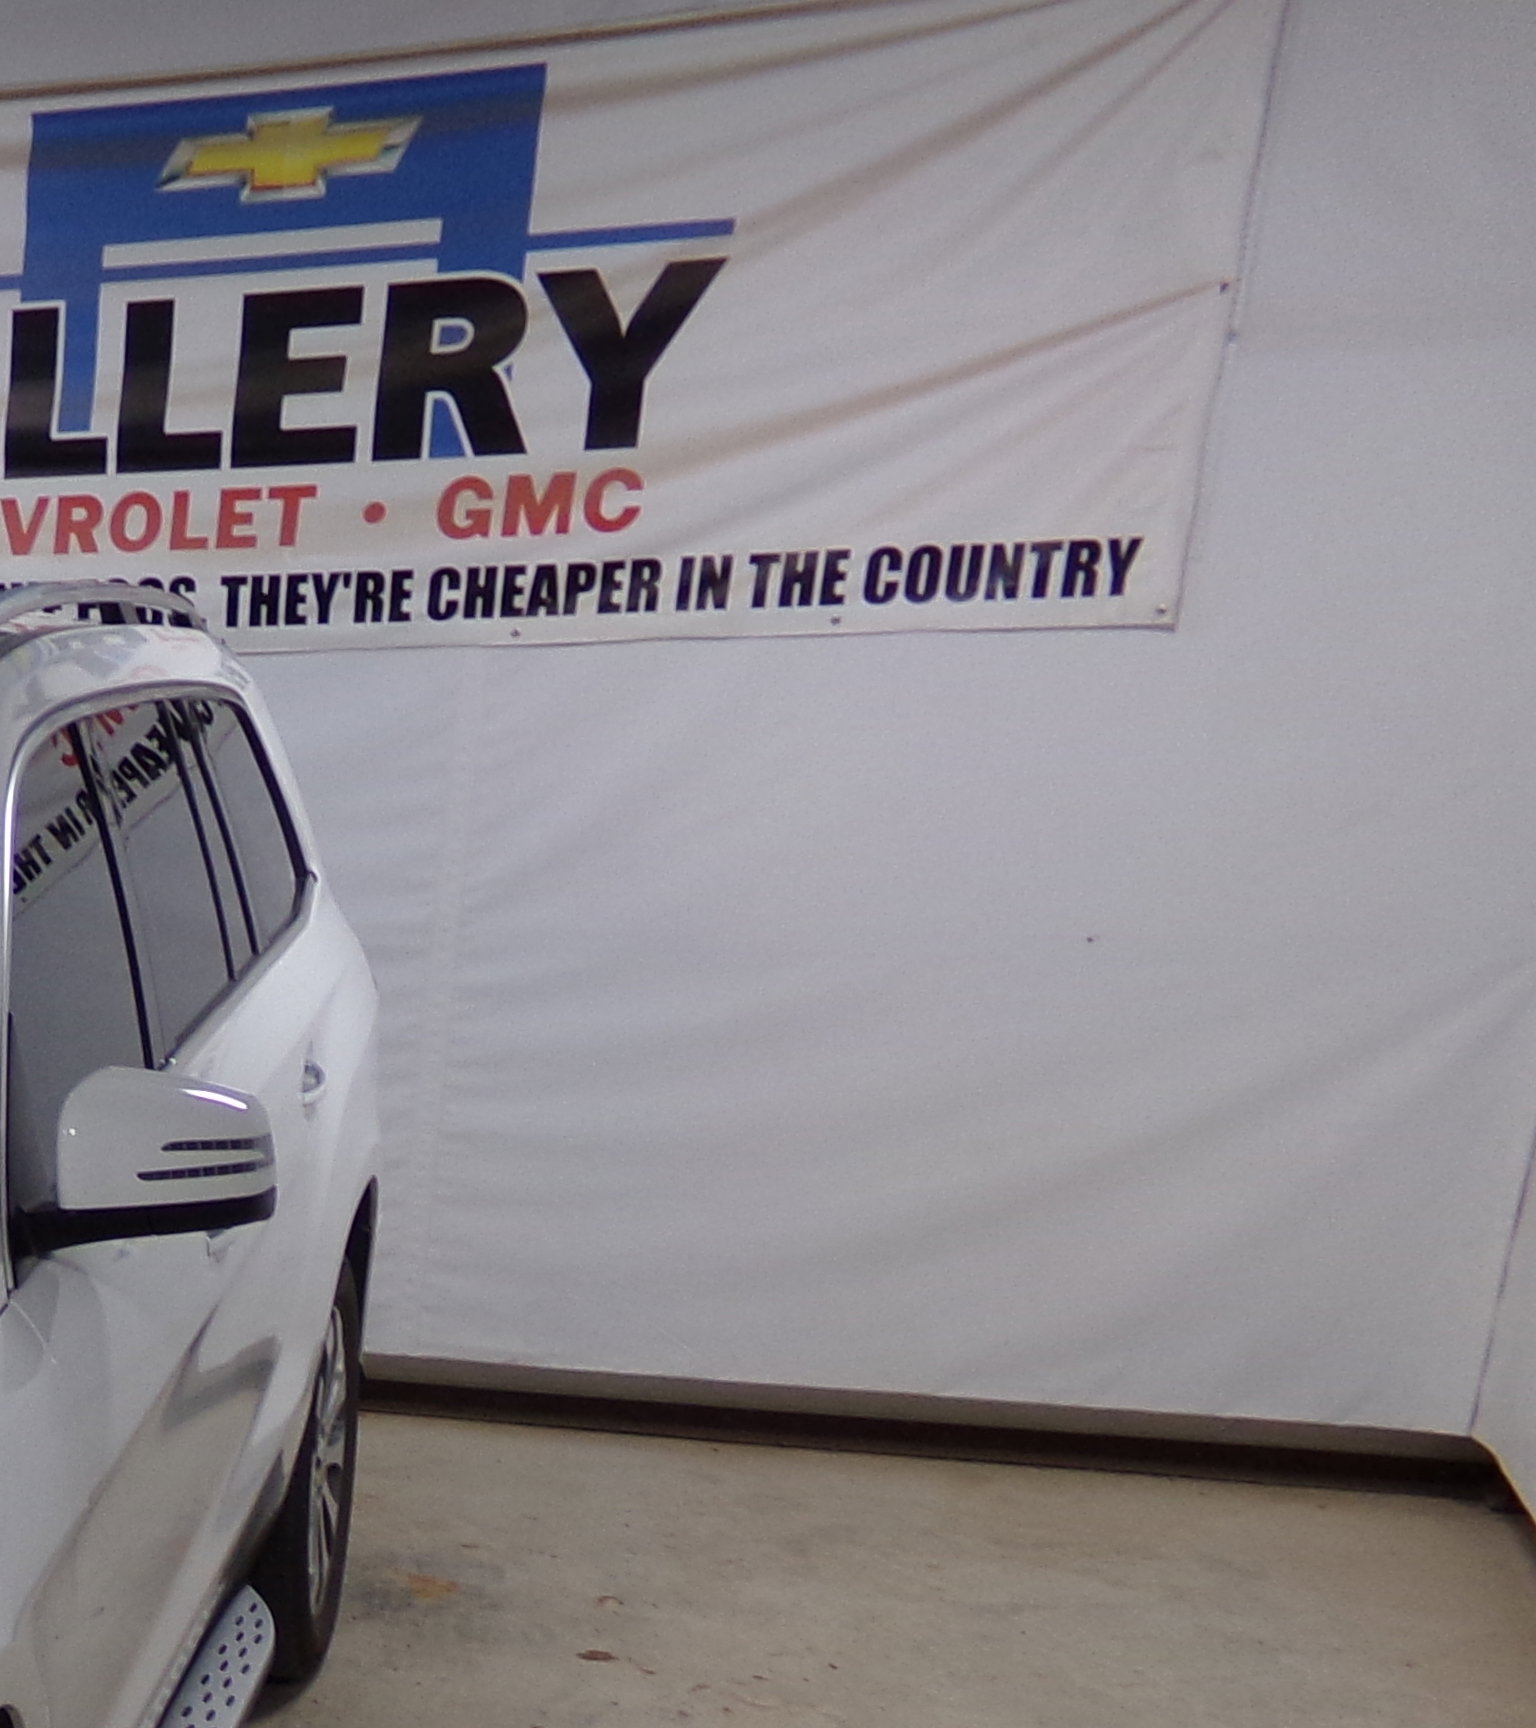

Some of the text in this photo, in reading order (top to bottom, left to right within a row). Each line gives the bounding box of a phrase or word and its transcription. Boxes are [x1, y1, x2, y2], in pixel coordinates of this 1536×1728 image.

[436, 468, 644, 540] GMC
[221, 569, 415, 627] THEY'RE
[427, 557, 663, 621] CHEAPER
[675, 554, 733, 611] IN
[749, 548, 852, 609] THE
[863, 536, 1144, 605] COUNTRY
